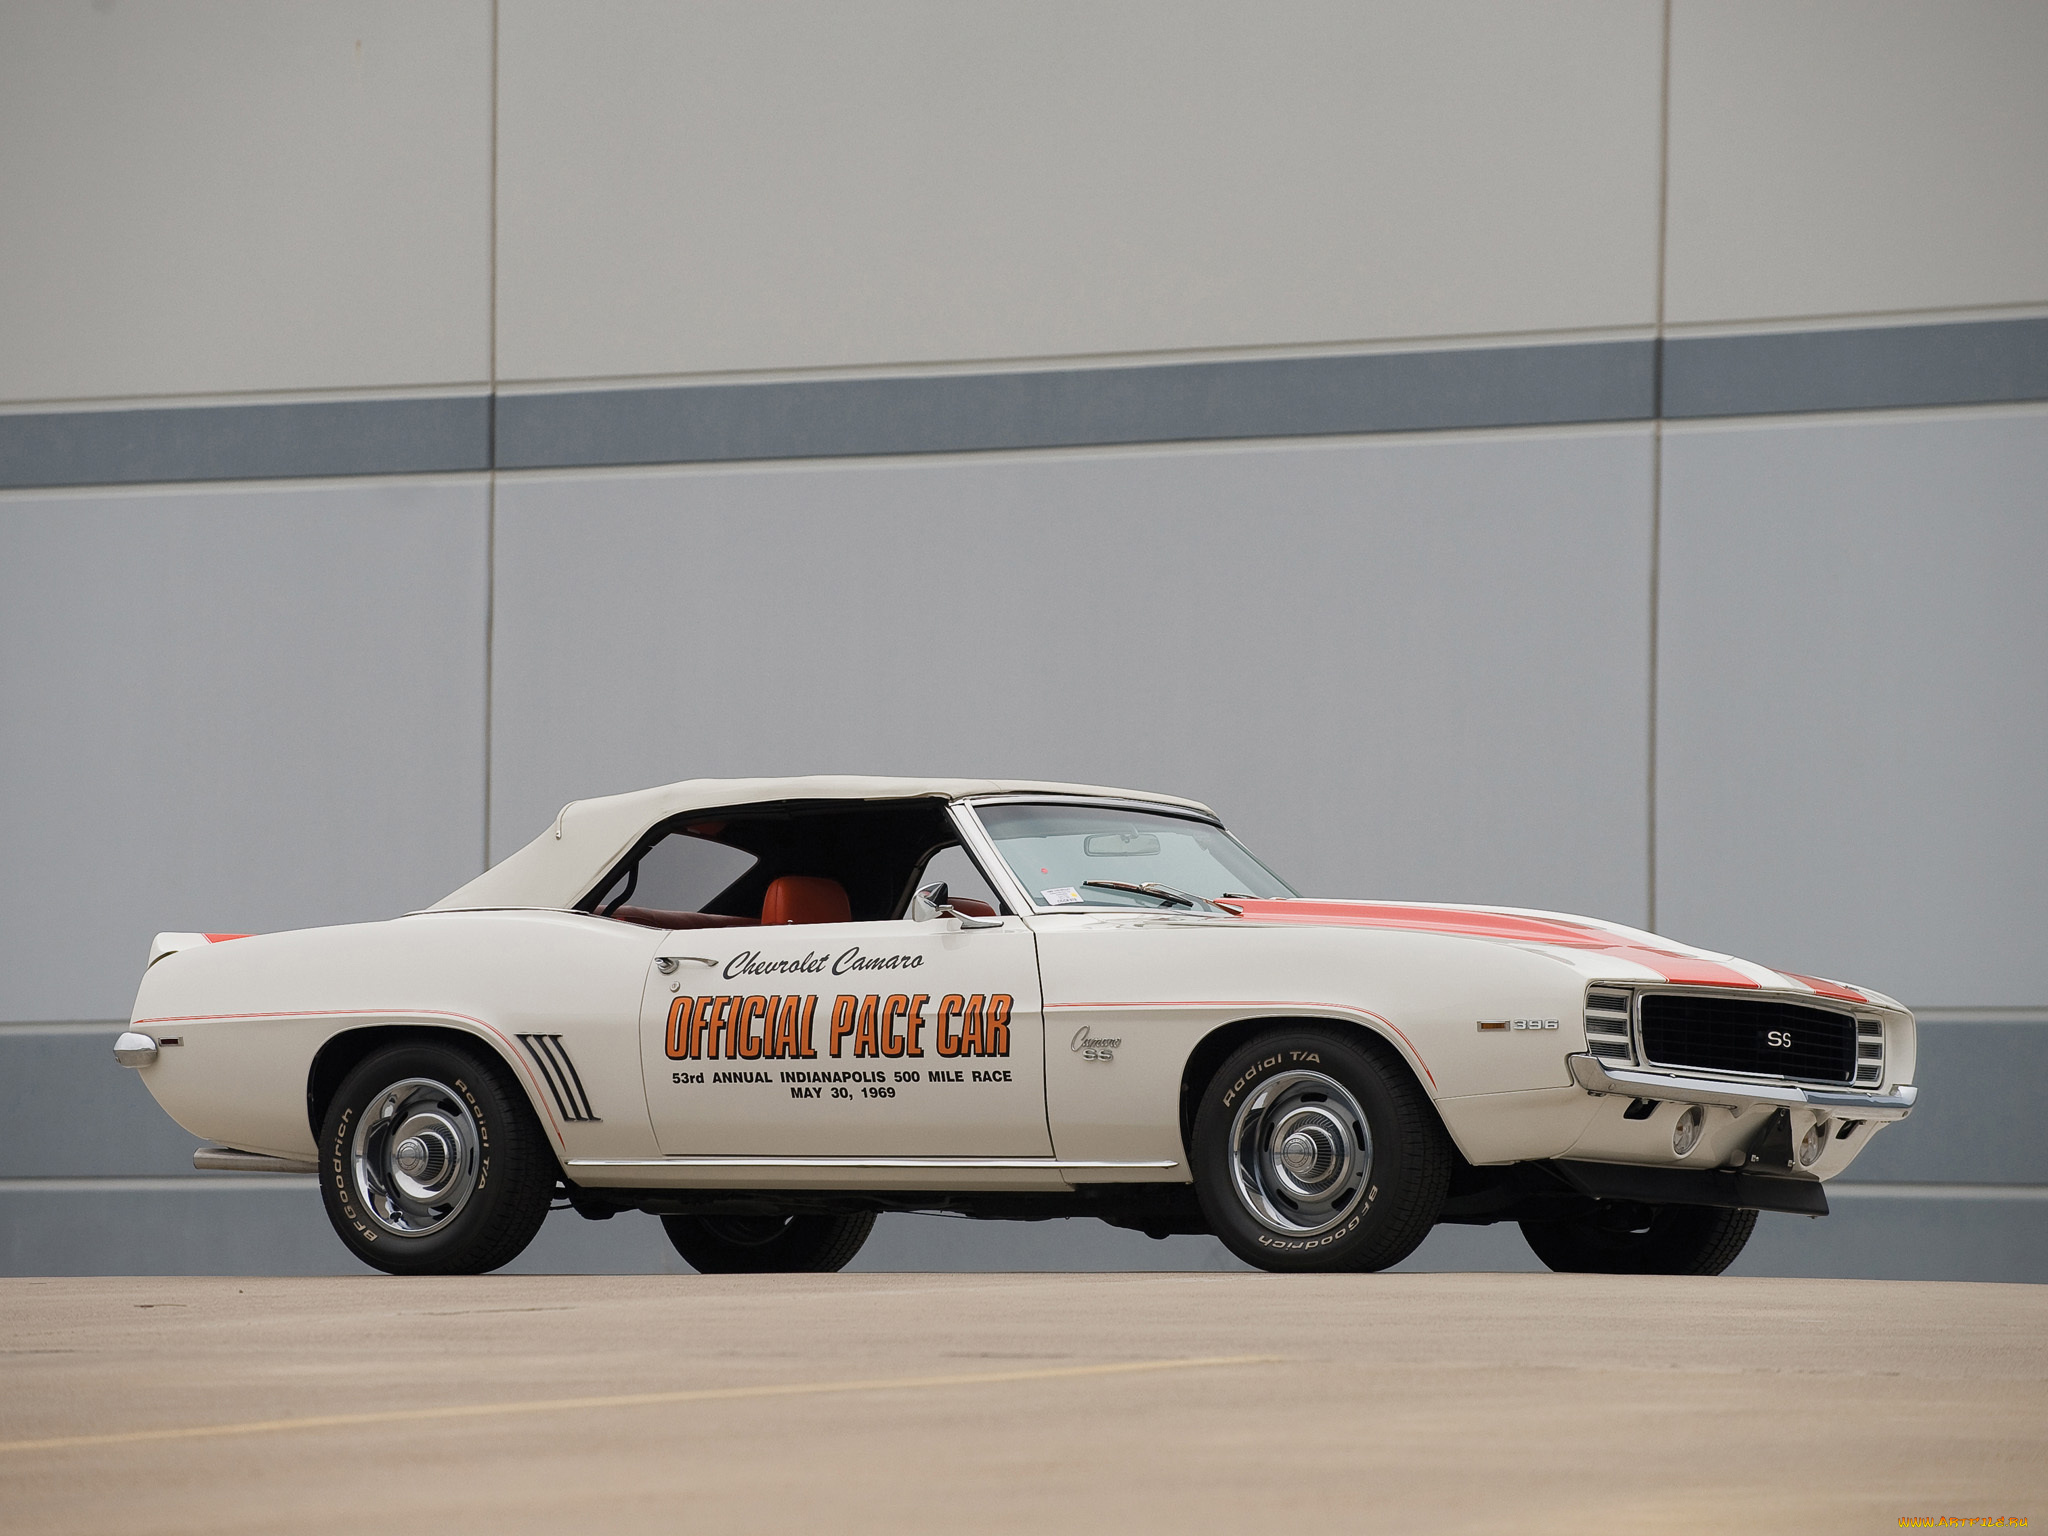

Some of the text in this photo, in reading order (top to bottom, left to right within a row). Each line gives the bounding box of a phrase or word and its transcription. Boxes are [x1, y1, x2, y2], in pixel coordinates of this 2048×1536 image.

[722, 946, 924, 980] Chevrolet Camaro
[665, 993, 1014, 1060] OFFICIAL PACE CAR
[1513, 1018, 1559, 1031] 396
[1071, 1025, 1122, 1052] Camaro
[1767, 1031, 1792, 1049] SS
[1082, 1048, 1113, 1062] SS
[672, 1070, 1013, 1084] 53rd ANNUAL INDIANAPOLIS 500 MILE RACE
[1223, 1051, 1320, 1107] Radial T/A
[790, 1087, 896, 1101] MAY 30, 1969
[455, 1079, 491, 1190] Radial T/A
